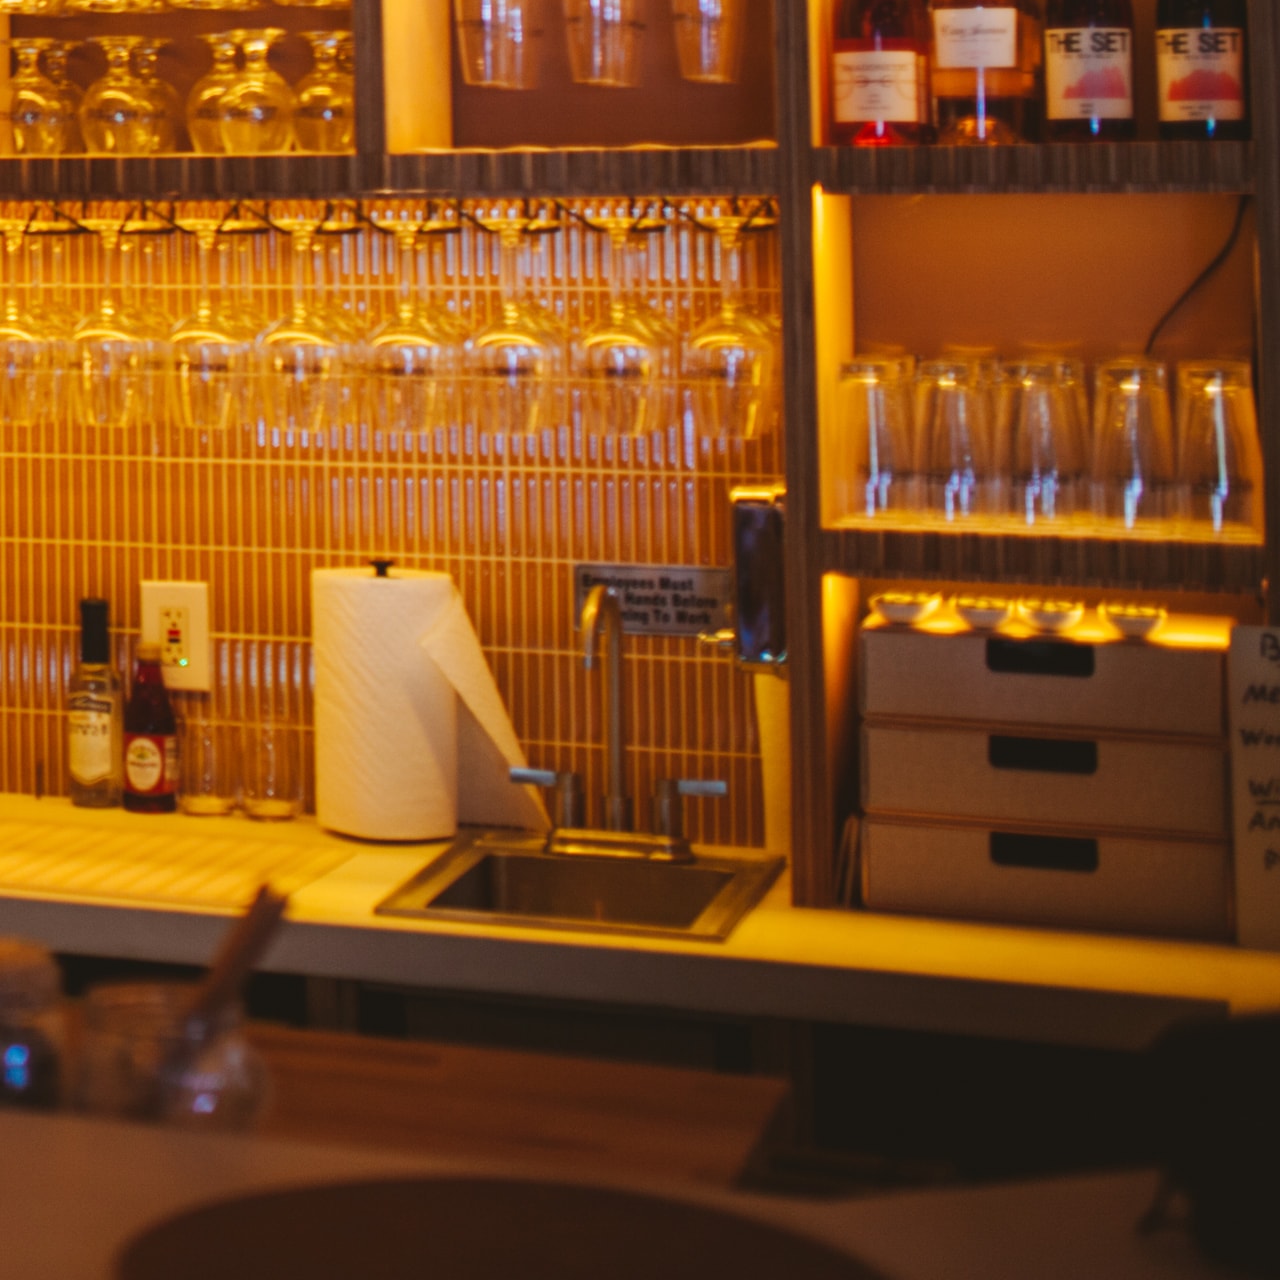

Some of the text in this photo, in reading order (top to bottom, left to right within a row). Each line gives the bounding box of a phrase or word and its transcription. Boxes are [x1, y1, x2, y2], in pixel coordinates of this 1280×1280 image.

[1048, 31, 1129, 54] THE SET
[1156, 31, 1240, 54] THE SET
[659, 576, 694, 591] Must
[624, 592, 718, 608] Hands Before
[653, 608, 670, 623] To
[675, 610, 711, 625] Work
